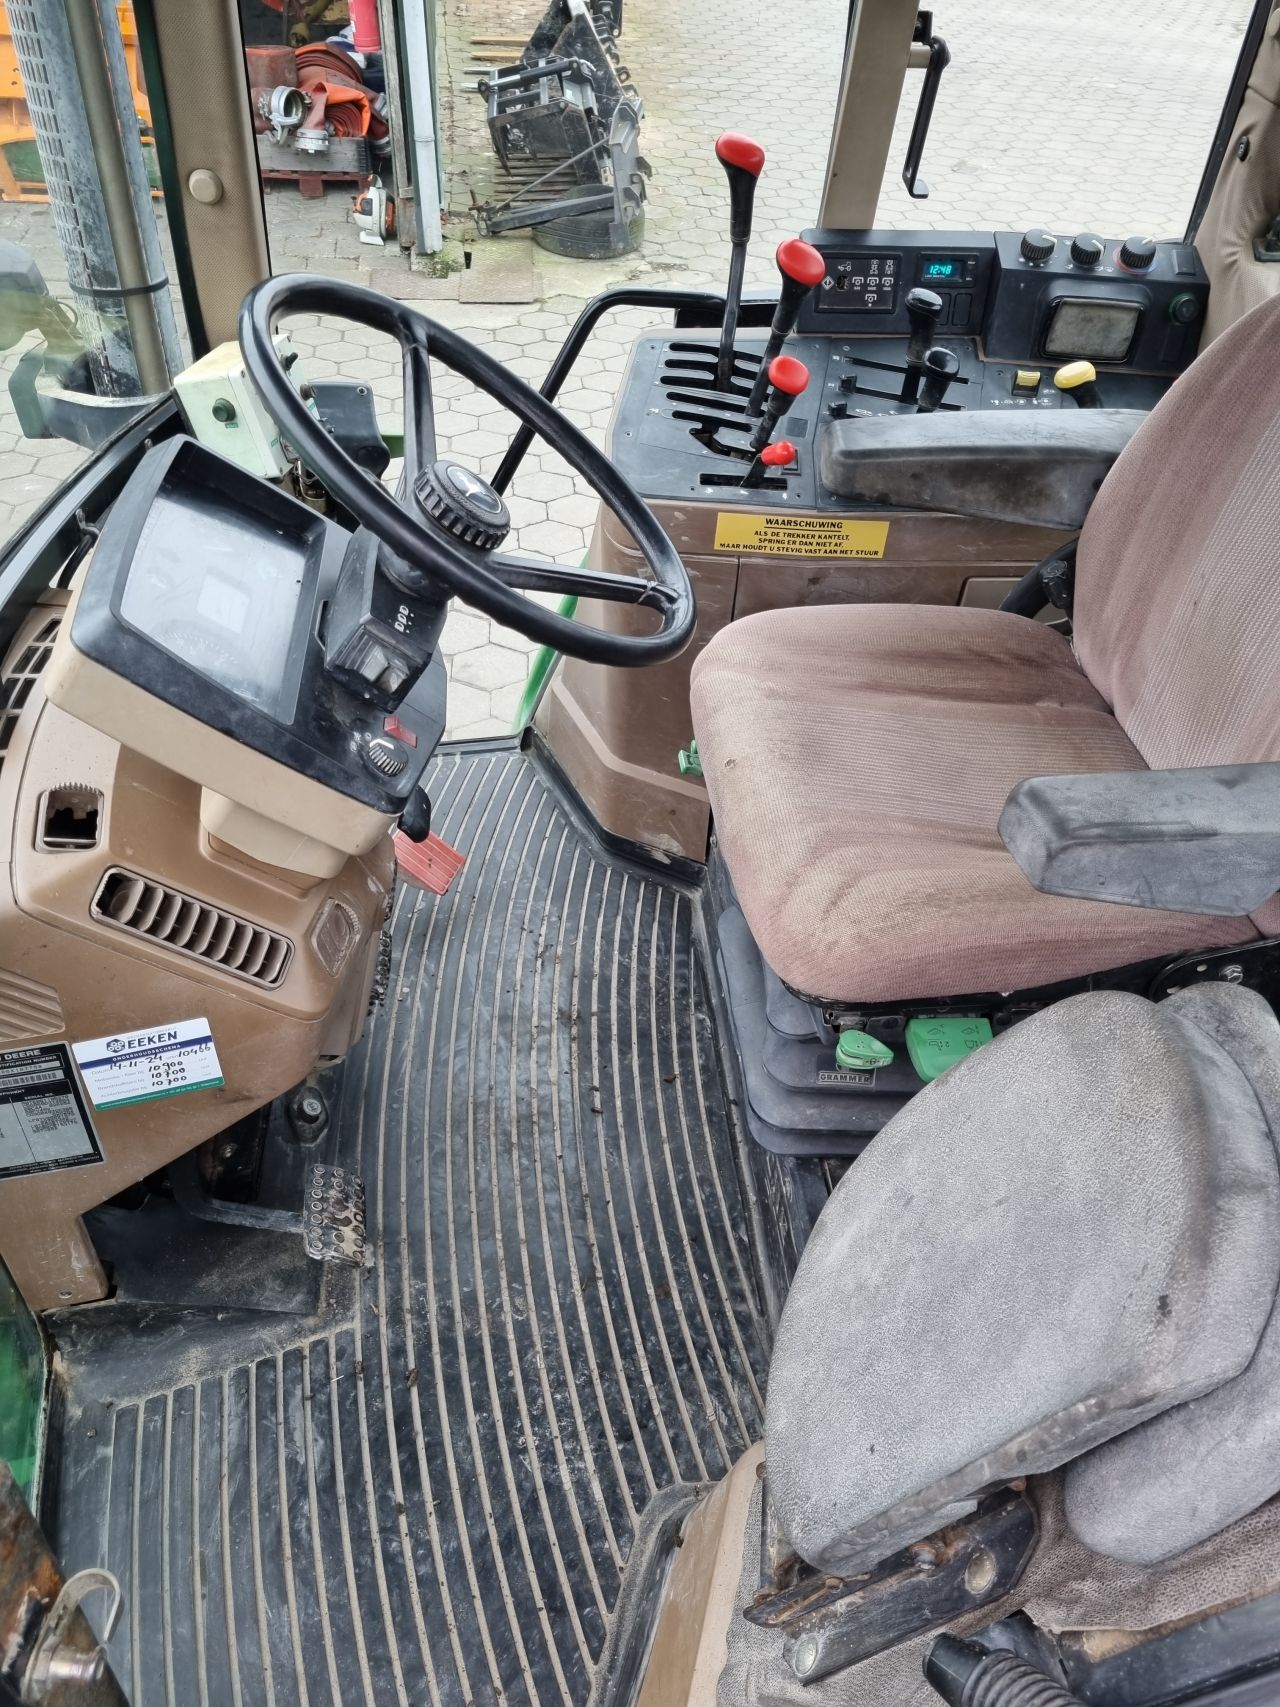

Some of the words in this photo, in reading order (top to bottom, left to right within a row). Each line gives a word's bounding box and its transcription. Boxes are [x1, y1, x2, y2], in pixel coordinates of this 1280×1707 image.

[929, 264, 953, 274] 12:48
[765, 518, 843, 529] WAARSCHUWING
[128, 1031, 178, 1049] EEKEN
[5, 1049, 41, 1060] DEERE
[820, 1073, 870, 1083] GRAMMER
